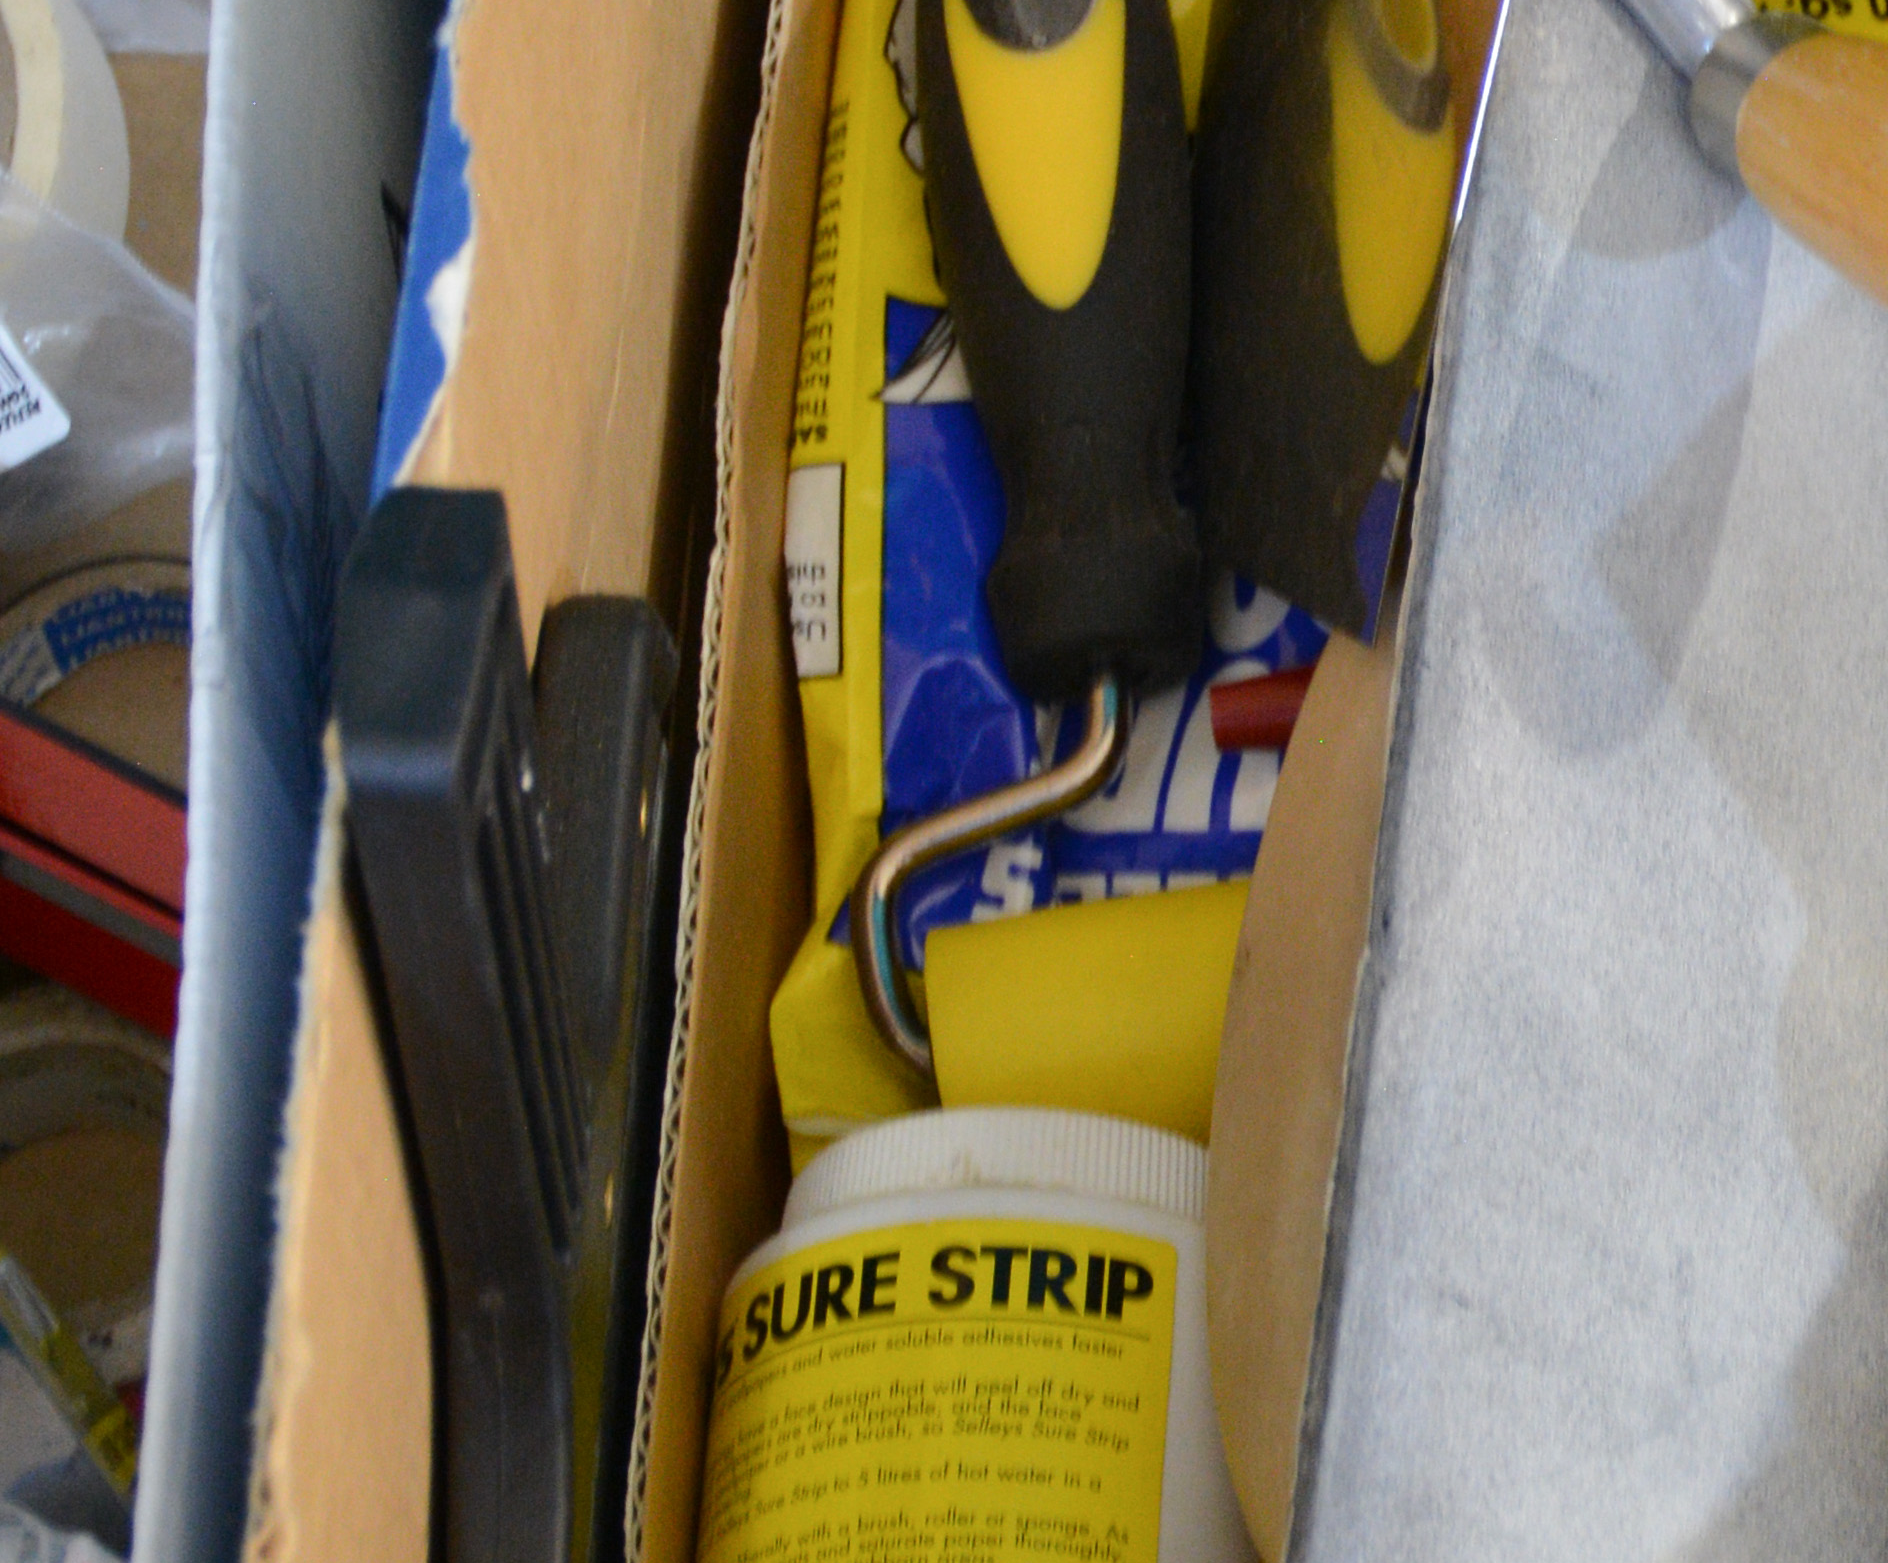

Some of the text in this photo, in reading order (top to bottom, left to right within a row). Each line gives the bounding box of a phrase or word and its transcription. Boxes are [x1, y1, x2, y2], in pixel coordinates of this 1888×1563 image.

[743, 1250, 901, 1361] SURE
[927, 1246, 1154, 1323] STRIP
[792, 1347, 823, 1373] and
[829, 1342, 876, 1362] water
[886, 1329, 954, 1351] soluble
[962, 1327, 1064, 1349] adhesives
[823, 1391, 881, 1413] design
[889, 1380, 925, 1399] that
[933, 1375, 967, 1395] will
[975, 1376, 1019, 1402] peel
[1027, 1378, 1053, 1397] off
[1062, 1381, 1094, 1409] dry
[1102, 1393, 1140, 1413] and
[808, 1417, 836, 1436] dry
[952, 1397, 991, 1415] and
[1000, 1398, 1030, 1415] the
[856, 1420, 912, 1444] brush,
[953, 1416, 1023, 1441] Selleys
[1032, 1420, 1077, 1441] Sure
[1085, 1426, 1130, 1453] Strip
[834, 1475, 850, 1493] to
[877, 1466, 921, 1485] litres
[929, 1460, 951, 1482] of
[957, 1459, 988, 1482] hot
[997, 1465, 1053, 1487] water
[1064, 1470, 1081, 1489] in
[1089, 1477, 1102, 1494] a
[797, 1523, 831, 1548] with
[924, 1508, 975, 1526] roller
[986, 1514, 1005, 1526] or
[1105, 1521, 1129, 1546] As
[816, 1540, 851, 1561] and
[858, 1536, 935, 1553] saturate
[943, 1535, 1003, 1553] paper
